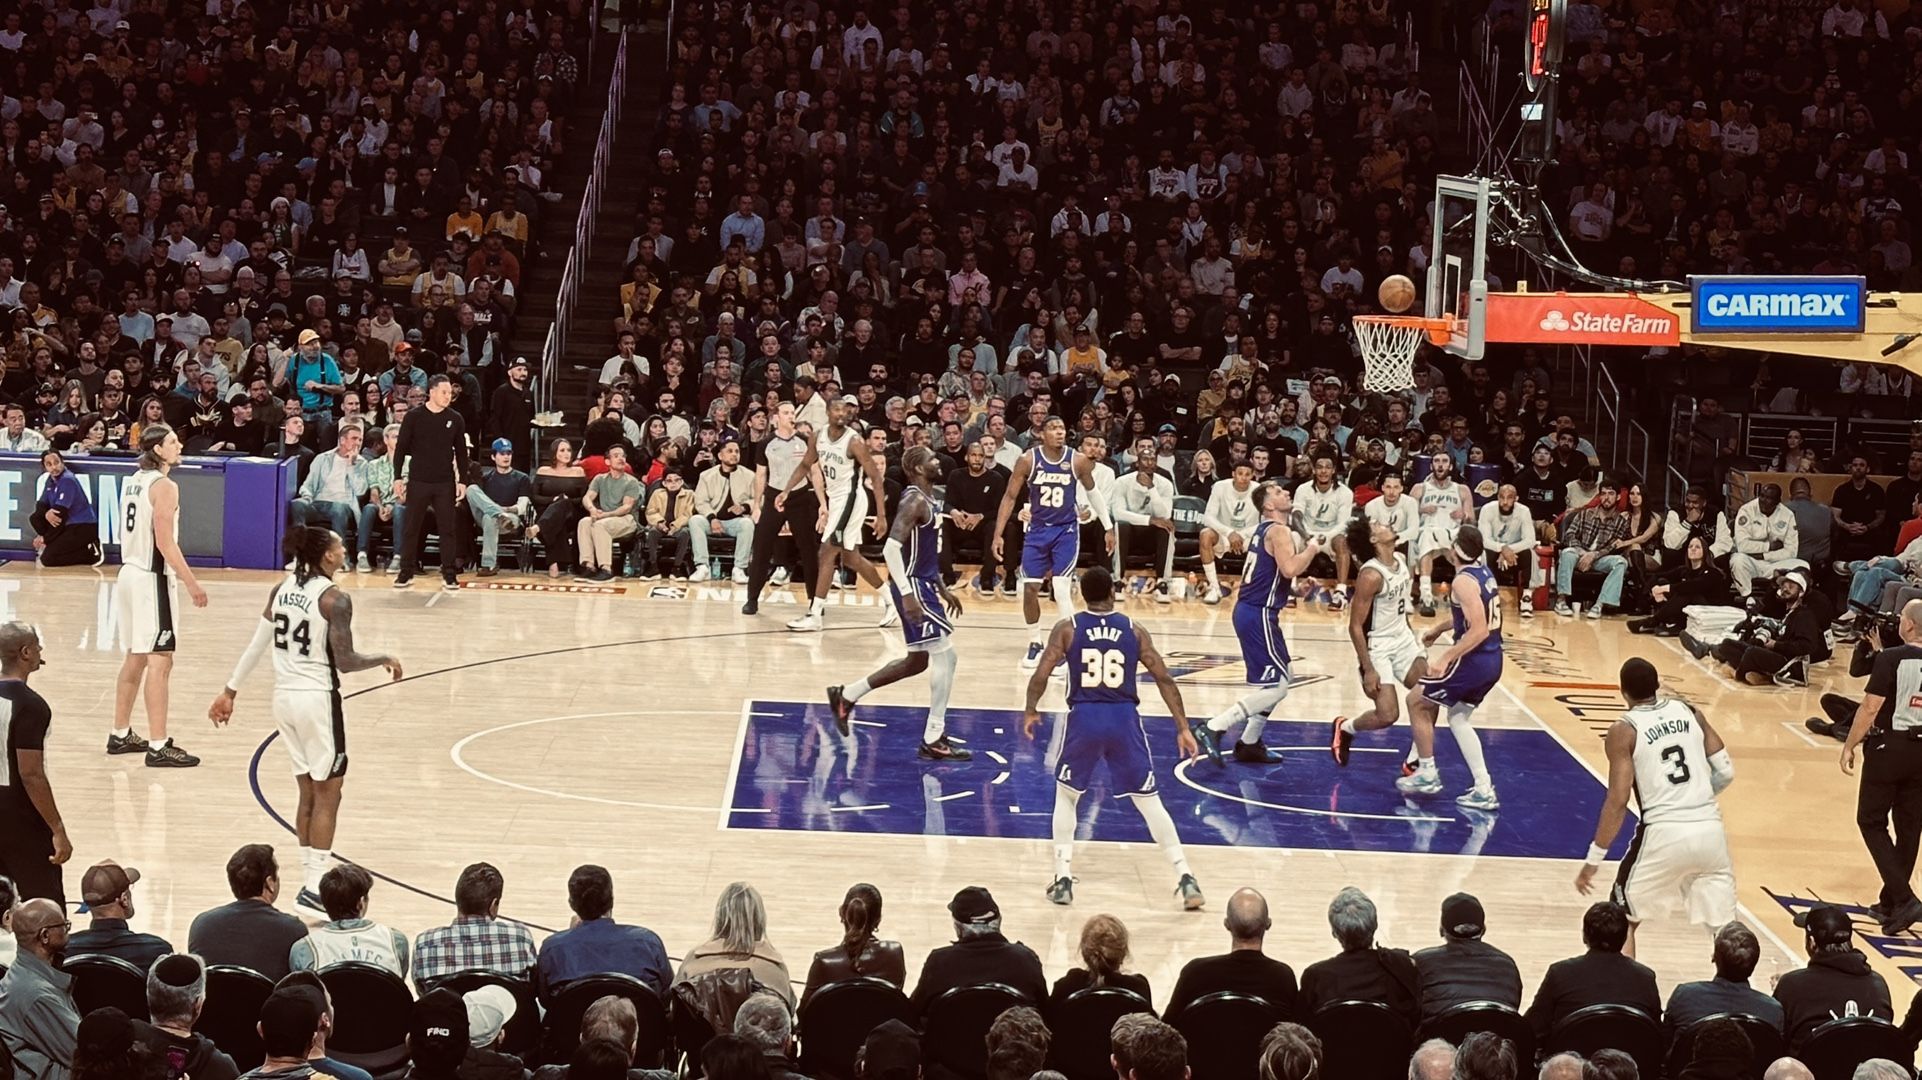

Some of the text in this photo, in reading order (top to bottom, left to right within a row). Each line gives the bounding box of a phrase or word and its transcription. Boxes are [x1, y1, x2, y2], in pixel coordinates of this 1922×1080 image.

[1040, 486, 1064, 508] 28
[126, 502, 136, 532] 8
[278, 592, 312, 614] VASSELL
[274, 613, 311, 656] 24
[1085, 626, 1123, 642] SMART
[1081, 648, 1126, 689] 36
[1644, 719, 1690, 745] JOHNSON
[1661, 744, 1691, 785] 3
